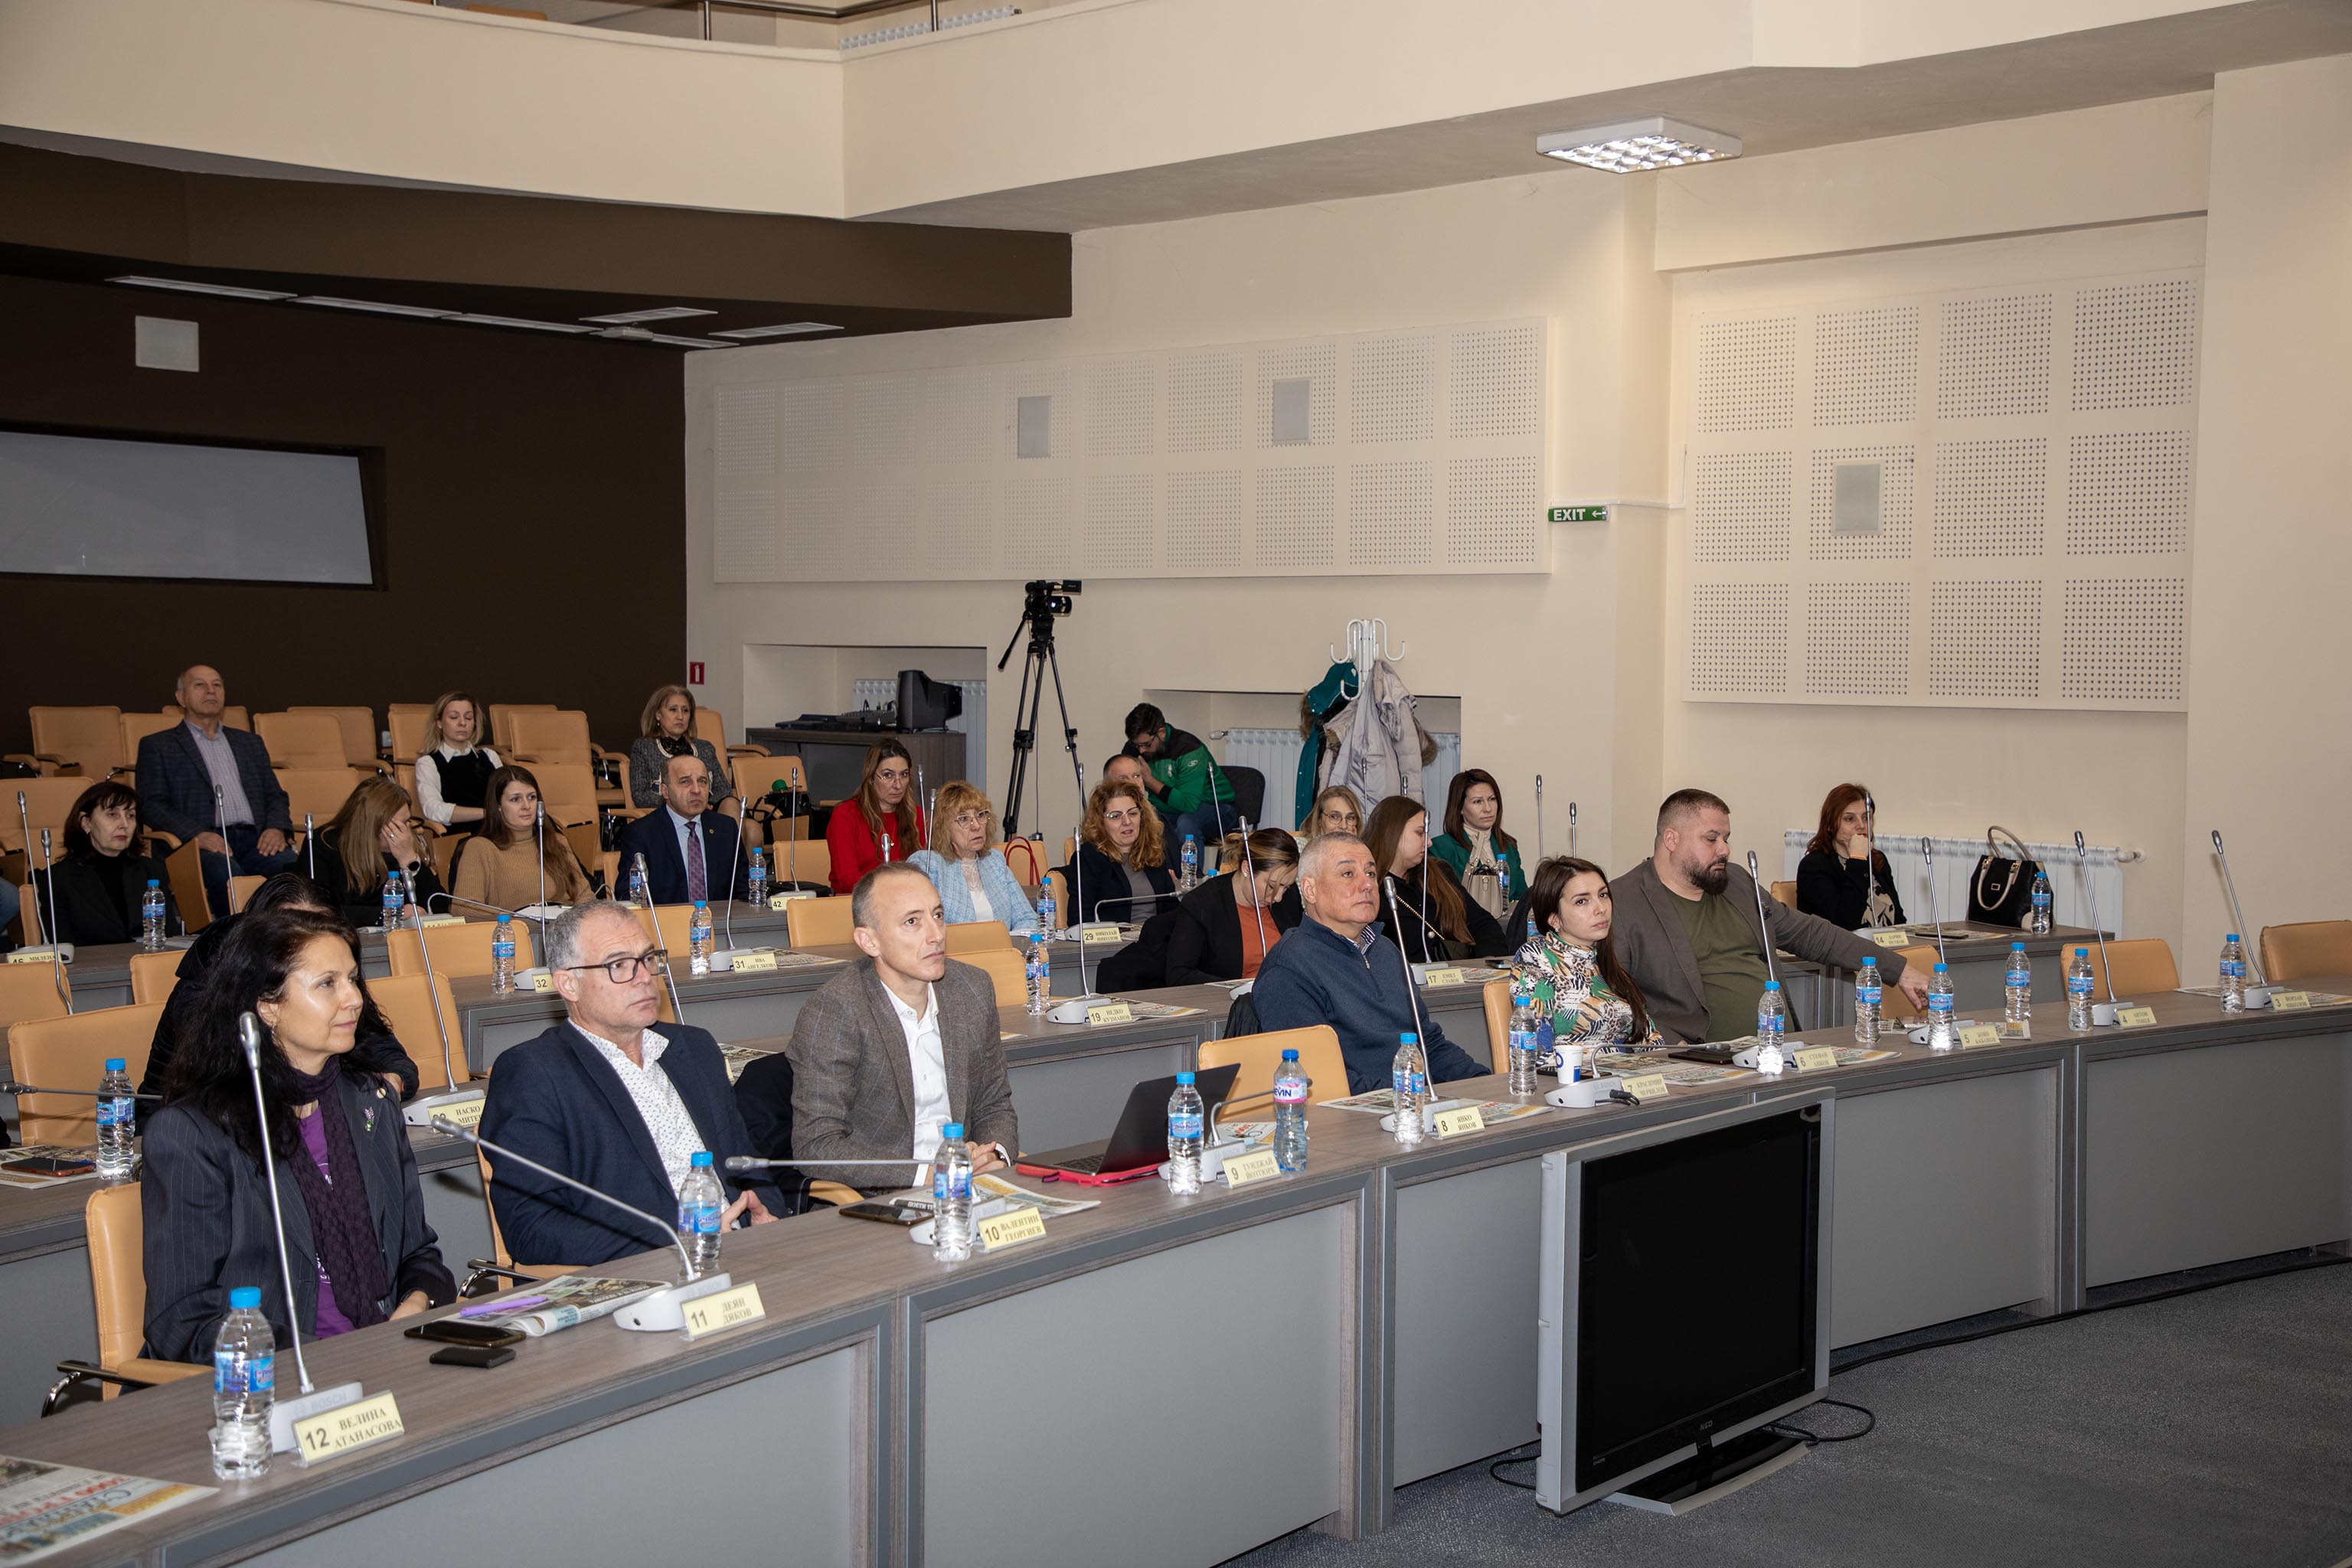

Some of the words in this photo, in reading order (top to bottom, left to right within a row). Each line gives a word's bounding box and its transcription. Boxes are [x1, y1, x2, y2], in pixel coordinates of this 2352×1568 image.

[1553, 508, 1586, 521] EXIT
[1084, 933, 1093, 941] 29
[1876, 936, 1884, 945] 14
[735, 960, 745, 969] 31
[536, 979, 547, 988] 32
[1429, 975, 1436, 984] 17
[2275, 998, 2282, 1008] 3
[1090, 1012, 1102, 1022] 19
[2122, 1014, 2128, 1024] 4
[1965, 1034, 1971, 1044] 5
[1800, 1056, 1806, 1067] 6
[1274, 1088, 1292, 1097] EVIN
[1627, 1084, 1632, 1093] 7
[456, 1105, 481, 1116] НАСКО
[1441, 1120, 1449, 1132] 8
[1230, 1167, 1239, 1180] 9
[1000, 1214, 1039, 1231] ВАЛЕНТИН
[985, 1227, 1000, 1243] 10
[1004, 1225, 1042, 1242] ГЕОРГИЕВ
[723, 1297, 746, 1312] ДЕЯН
[691, 1309, 708, 1328] 11
[723, 1308, 753, 1325] ДЯКОВ
[338, 1407, 387, 1431] ВЕЛИНА
[306, 1427, 330, 1451] 12
[333, 1419, 402, 1449] АТАНАСОВА
